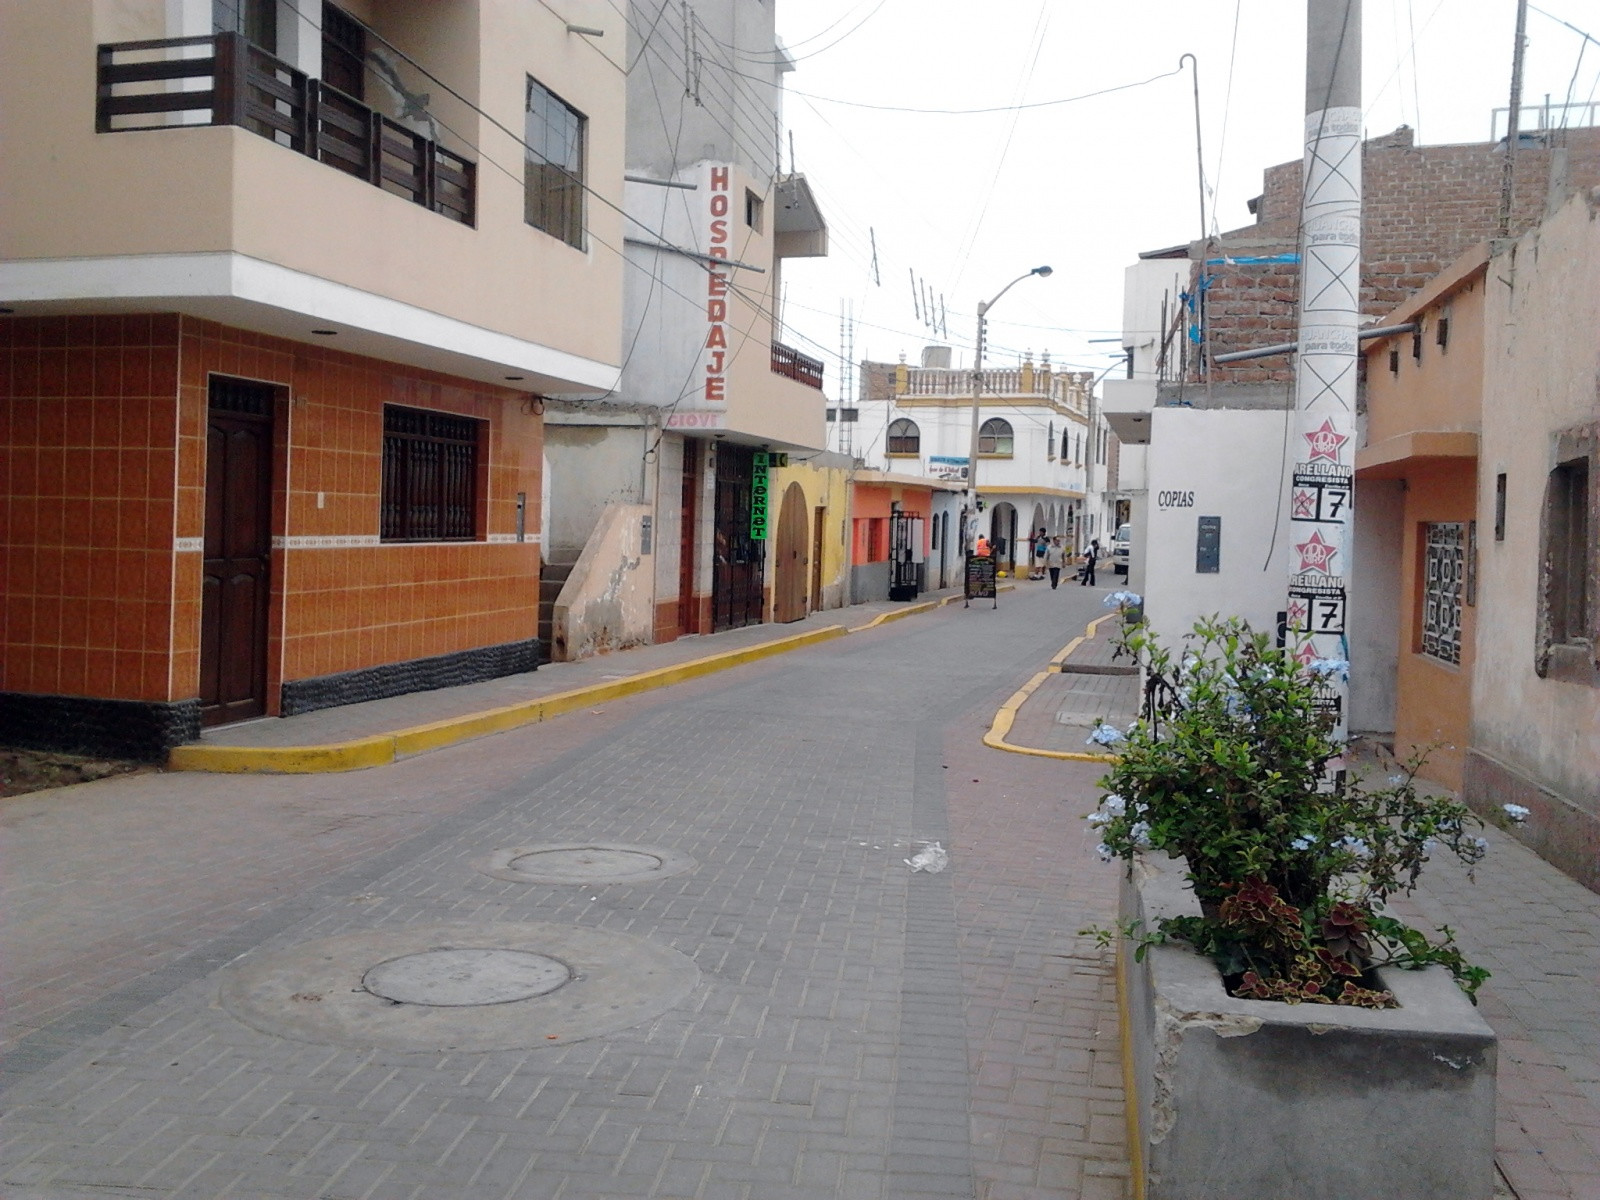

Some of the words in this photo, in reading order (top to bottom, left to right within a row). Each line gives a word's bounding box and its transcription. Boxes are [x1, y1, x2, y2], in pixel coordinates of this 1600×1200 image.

[705, 166, 729, 401] HOSPEDAJE
[1294, 463, 1351, 477] ARELLANO
[1295, 475, 1349, 484] CONGRESISTA
[1158, 490, 1194, 507] COPIAS
[1328, 490, 1346, 518] 7
[1290, 575, 1344, 588] RELLANO
[1318, 602, 1338, 629] 7
